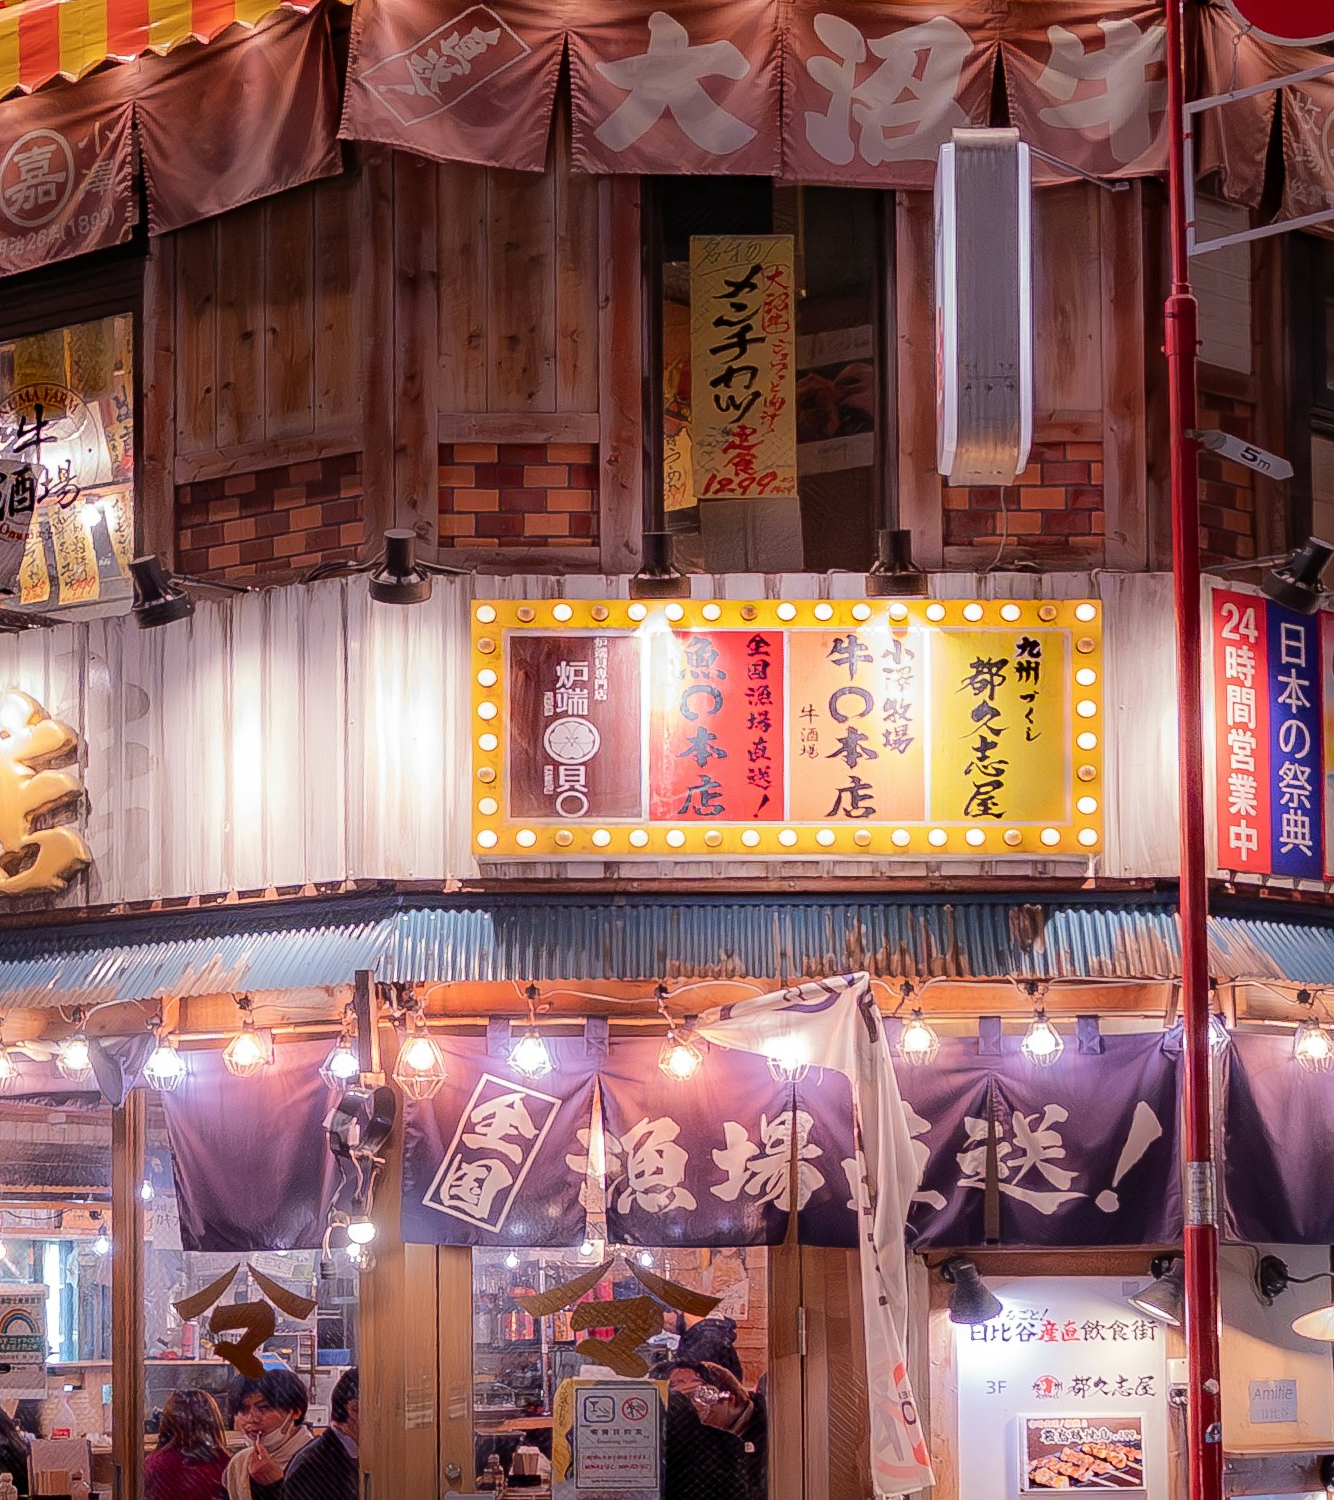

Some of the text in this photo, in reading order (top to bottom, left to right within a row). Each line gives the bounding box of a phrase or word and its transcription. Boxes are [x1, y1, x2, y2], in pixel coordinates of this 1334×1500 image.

[4, 144, 66, 213] 嘉
[12, 402, 58, 464] 牛
[556, 661, 589, 716] 炉端
[881, 639, 915, 754] 小澤牧場
[799, 704, 820, 760] 牛酒場
[959, 655, 1010, 820] 都久志屋
[1220, 602, 1259, 863] 24時間営業中
[1276, 621, 1314, 858] 日本の祭典
[440, 1089, 541, 1219] 全国
[969, 1319, 1158, 1342] 日比谷産直飲食街
[986, 1375, 1156, 1398] 3F 都久志屋
